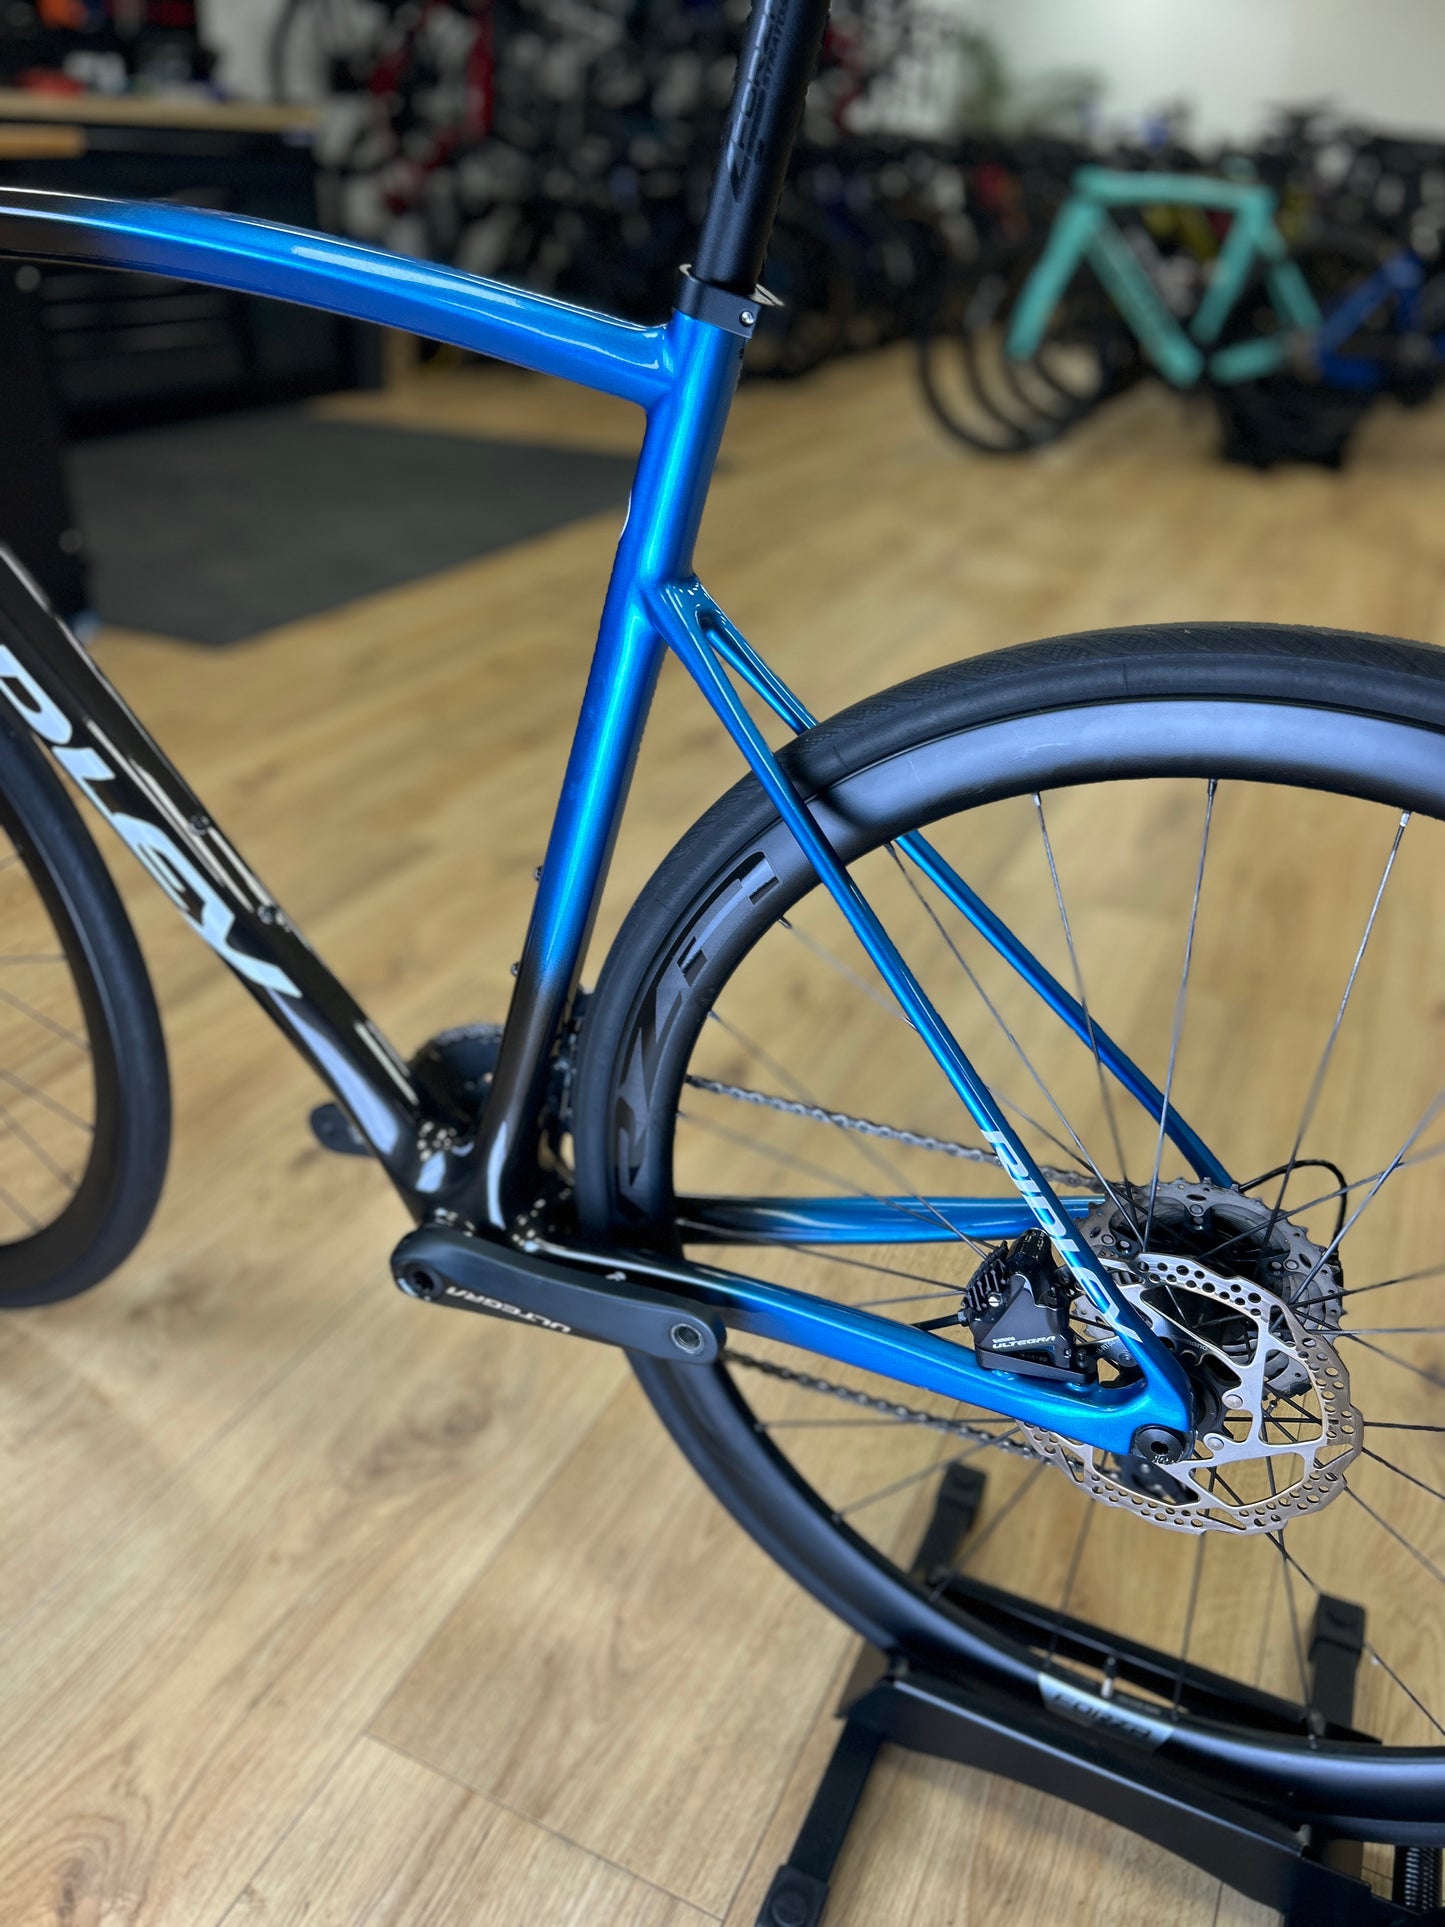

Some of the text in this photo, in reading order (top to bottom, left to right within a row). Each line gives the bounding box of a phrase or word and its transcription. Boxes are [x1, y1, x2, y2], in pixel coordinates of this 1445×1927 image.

[981, 1130, 1143, 1342] RIDLEY
[446, 1286, 572, 1334] ULTEGRA
[992, 1335, 1056, 1349] ULTEGRA
